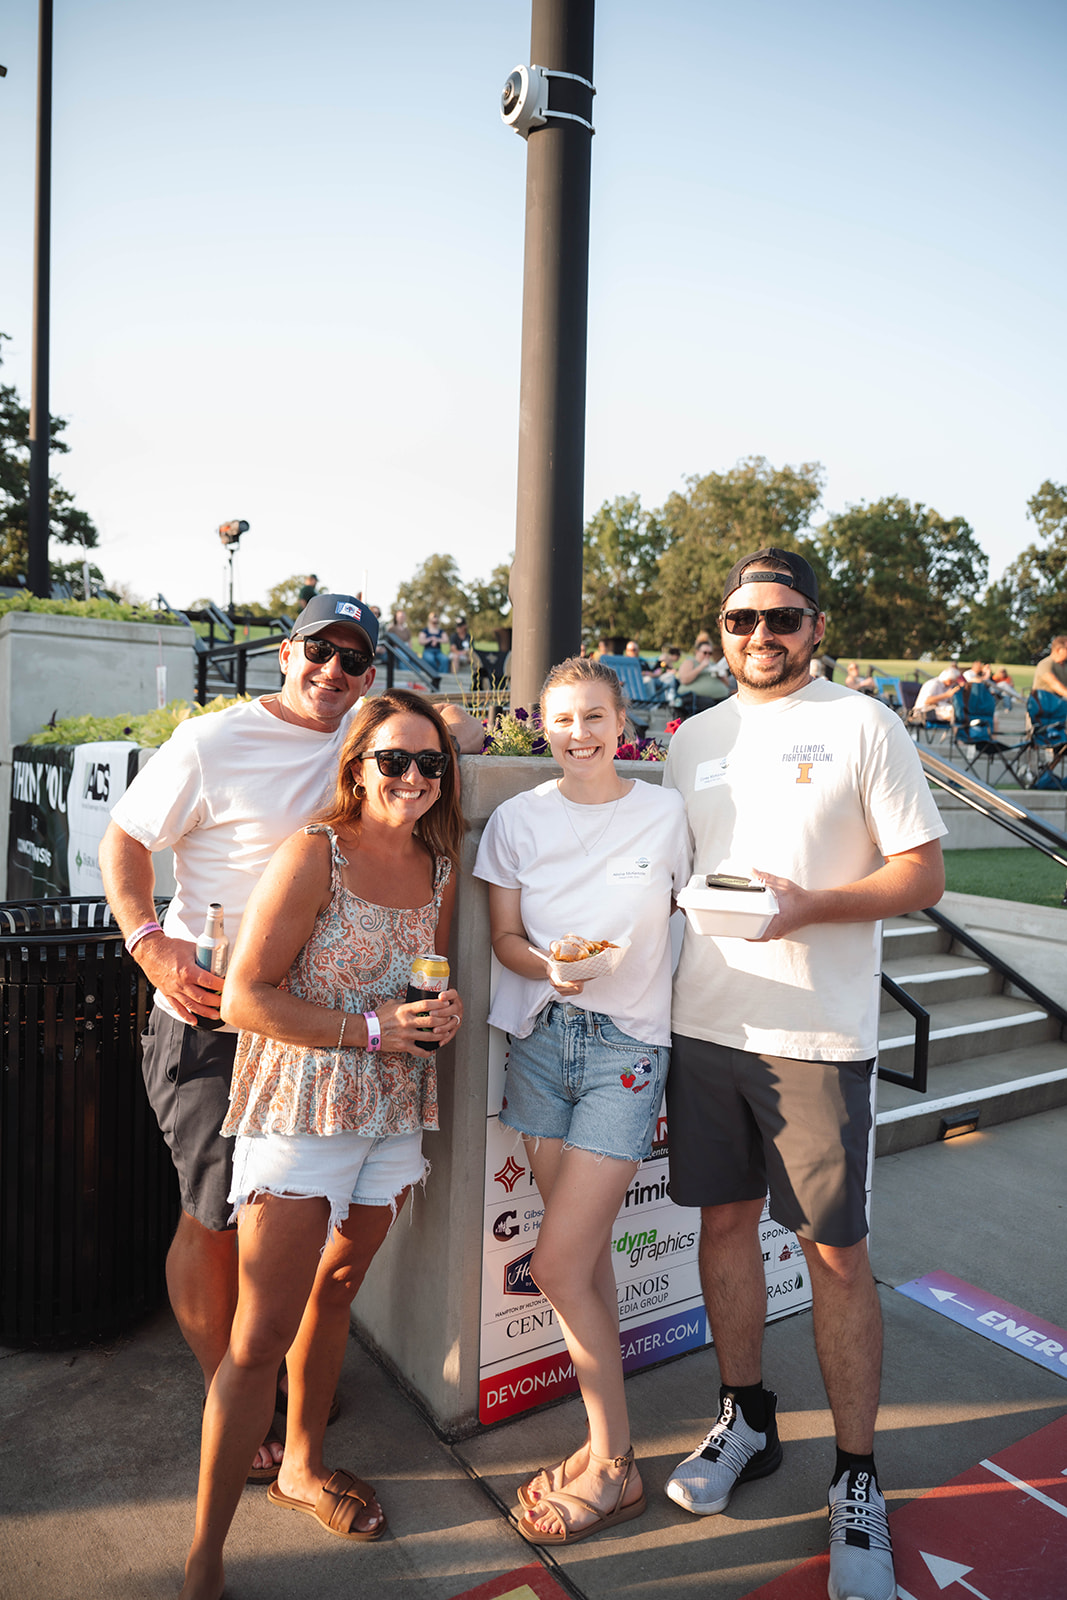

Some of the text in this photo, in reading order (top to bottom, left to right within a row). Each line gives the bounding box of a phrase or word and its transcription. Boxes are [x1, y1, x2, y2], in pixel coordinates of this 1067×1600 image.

[782, 753, 834, 762] FIGHTING ILLINI
[792, 744, 825, 753] ILLINOIS
[796, 763, 814, 784] I
[616, 1229, 657, 1255] dyna
[630, 1232, 695, 1268] graphics
[640, 1292, 669, 1309] GROUP
[506, 1309, 559, 1338] CENT
[486, 1362, 577, 1409] DEVONAM
[711, 1397, 733, 1446] adas
[851, 1471, 869, 1525] ddas
